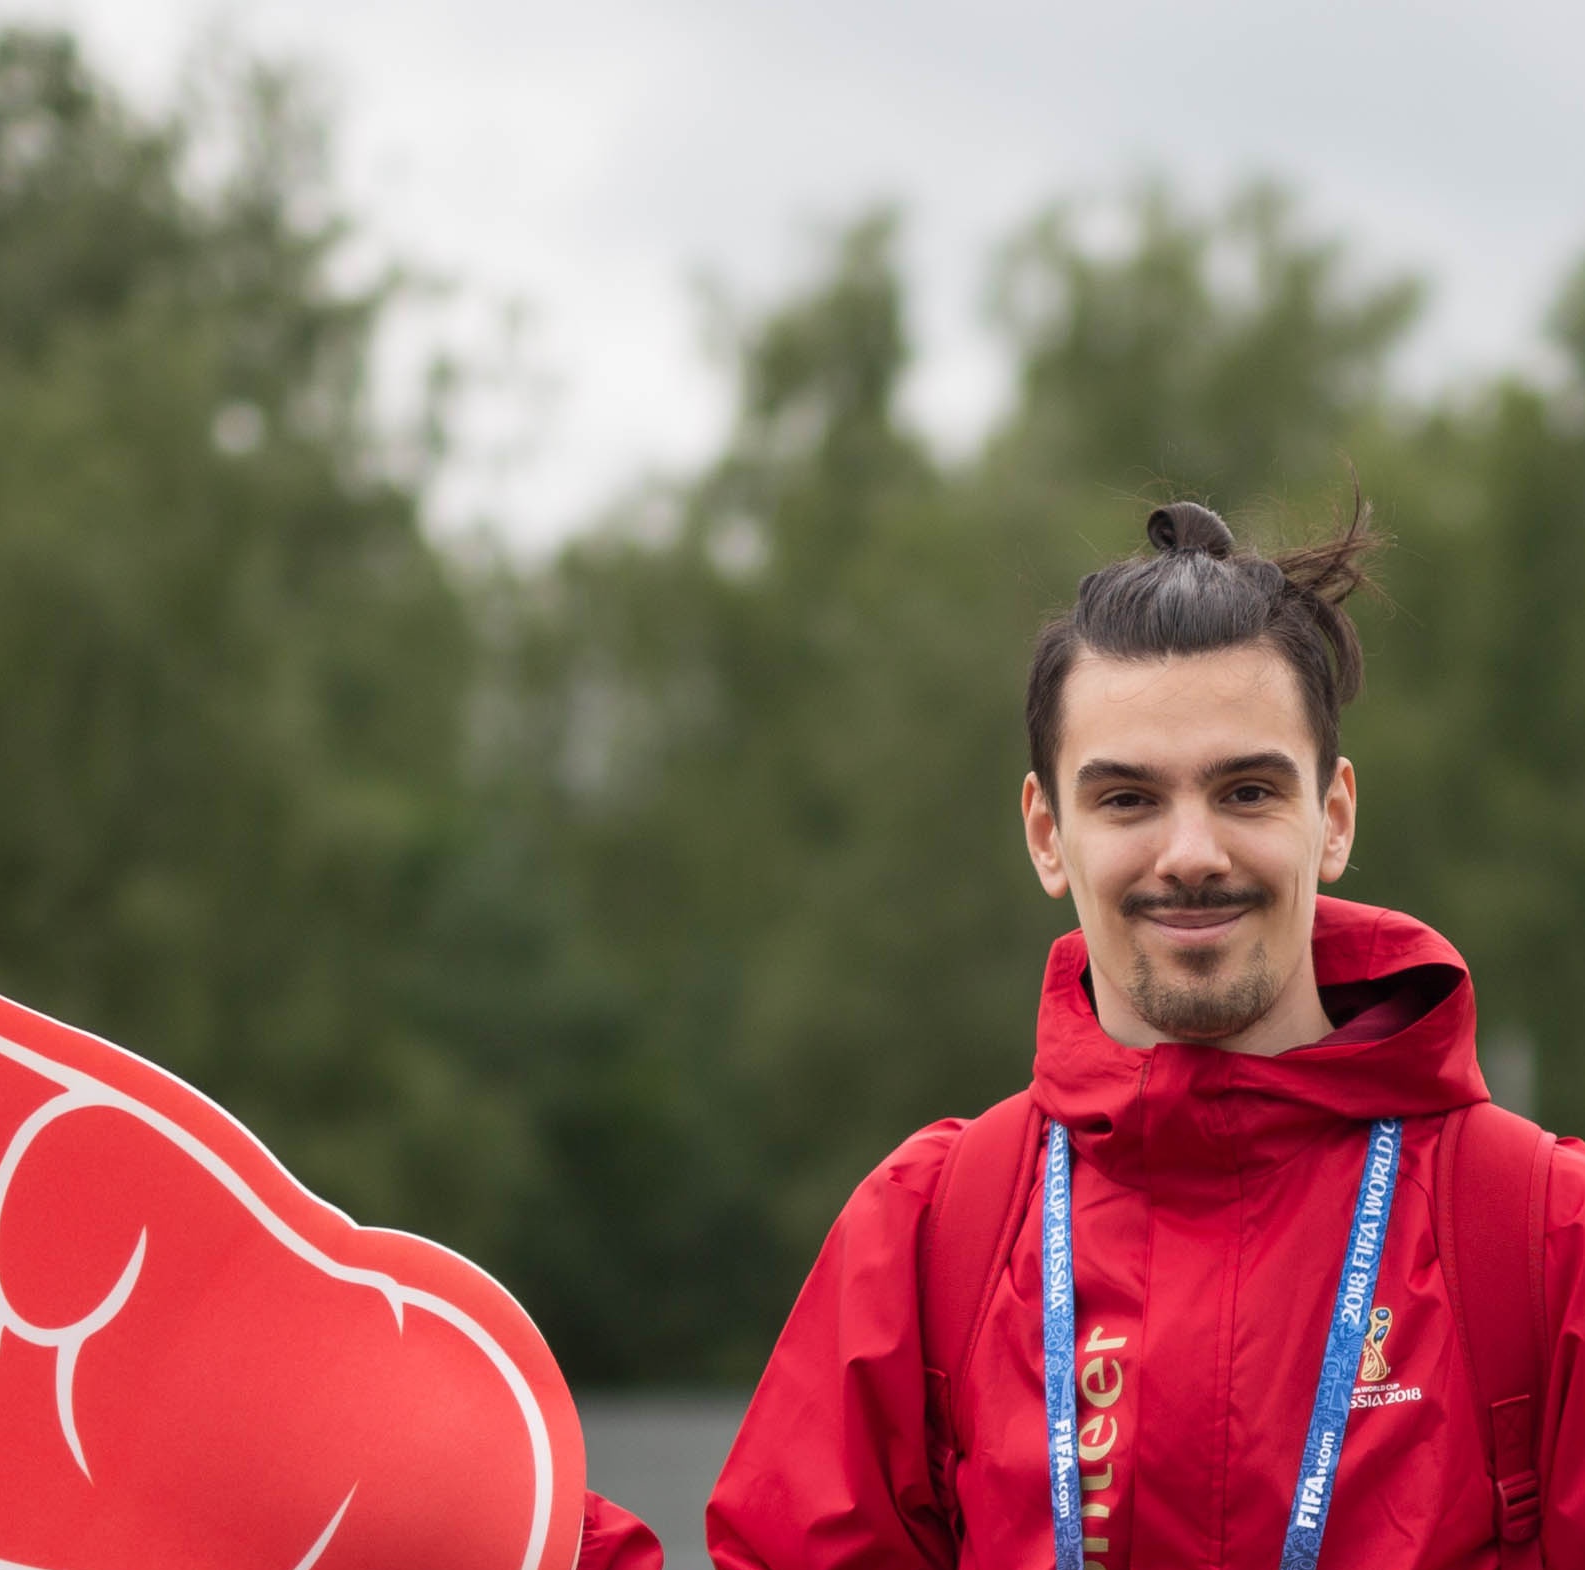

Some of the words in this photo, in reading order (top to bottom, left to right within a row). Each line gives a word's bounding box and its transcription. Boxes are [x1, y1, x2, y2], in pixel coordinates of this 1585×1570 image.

[1049, 1176, 1066, 1220] CUP
[1363, 1135, 1394, 1217] WORLD
[1049, 1227, 1068, 1312] RUSSIA
[1352, 1222, 1380, 1269] FIFA
[1341, 1272, 1367, 1325] 2018
[1350, 1394, 1384, 1409] SSIA
[1385, 1387, 1423, 1405] 2018
